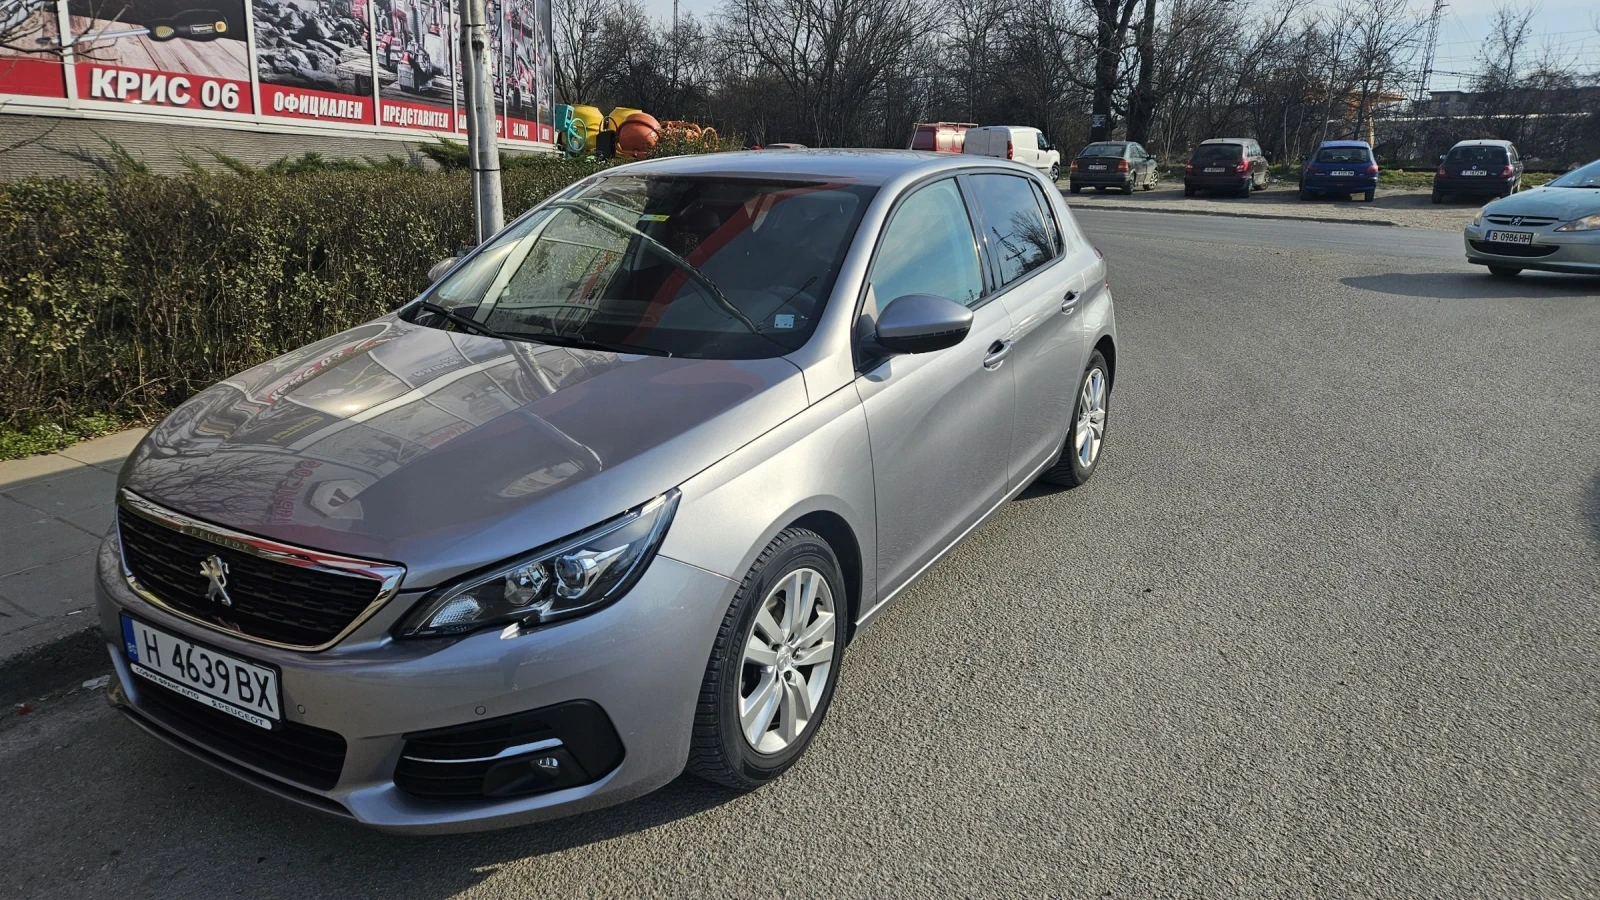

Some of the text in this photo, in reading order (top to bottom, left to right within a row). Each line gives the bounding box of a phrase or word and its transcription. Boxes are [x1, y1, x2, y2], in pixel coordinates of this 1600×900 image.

[92, 67, 240, 109] КРИС 06
[274, 91, 363, 120] ОФИЦИАЛЕН
[383, 104, 449, 129] ПРЕДСТАВИТЕЛ
[191, 528, 249, 550] PEUGEOT
[143, 630, 161, 668] H
[218, 702, 265, 726] PEUGEOT
